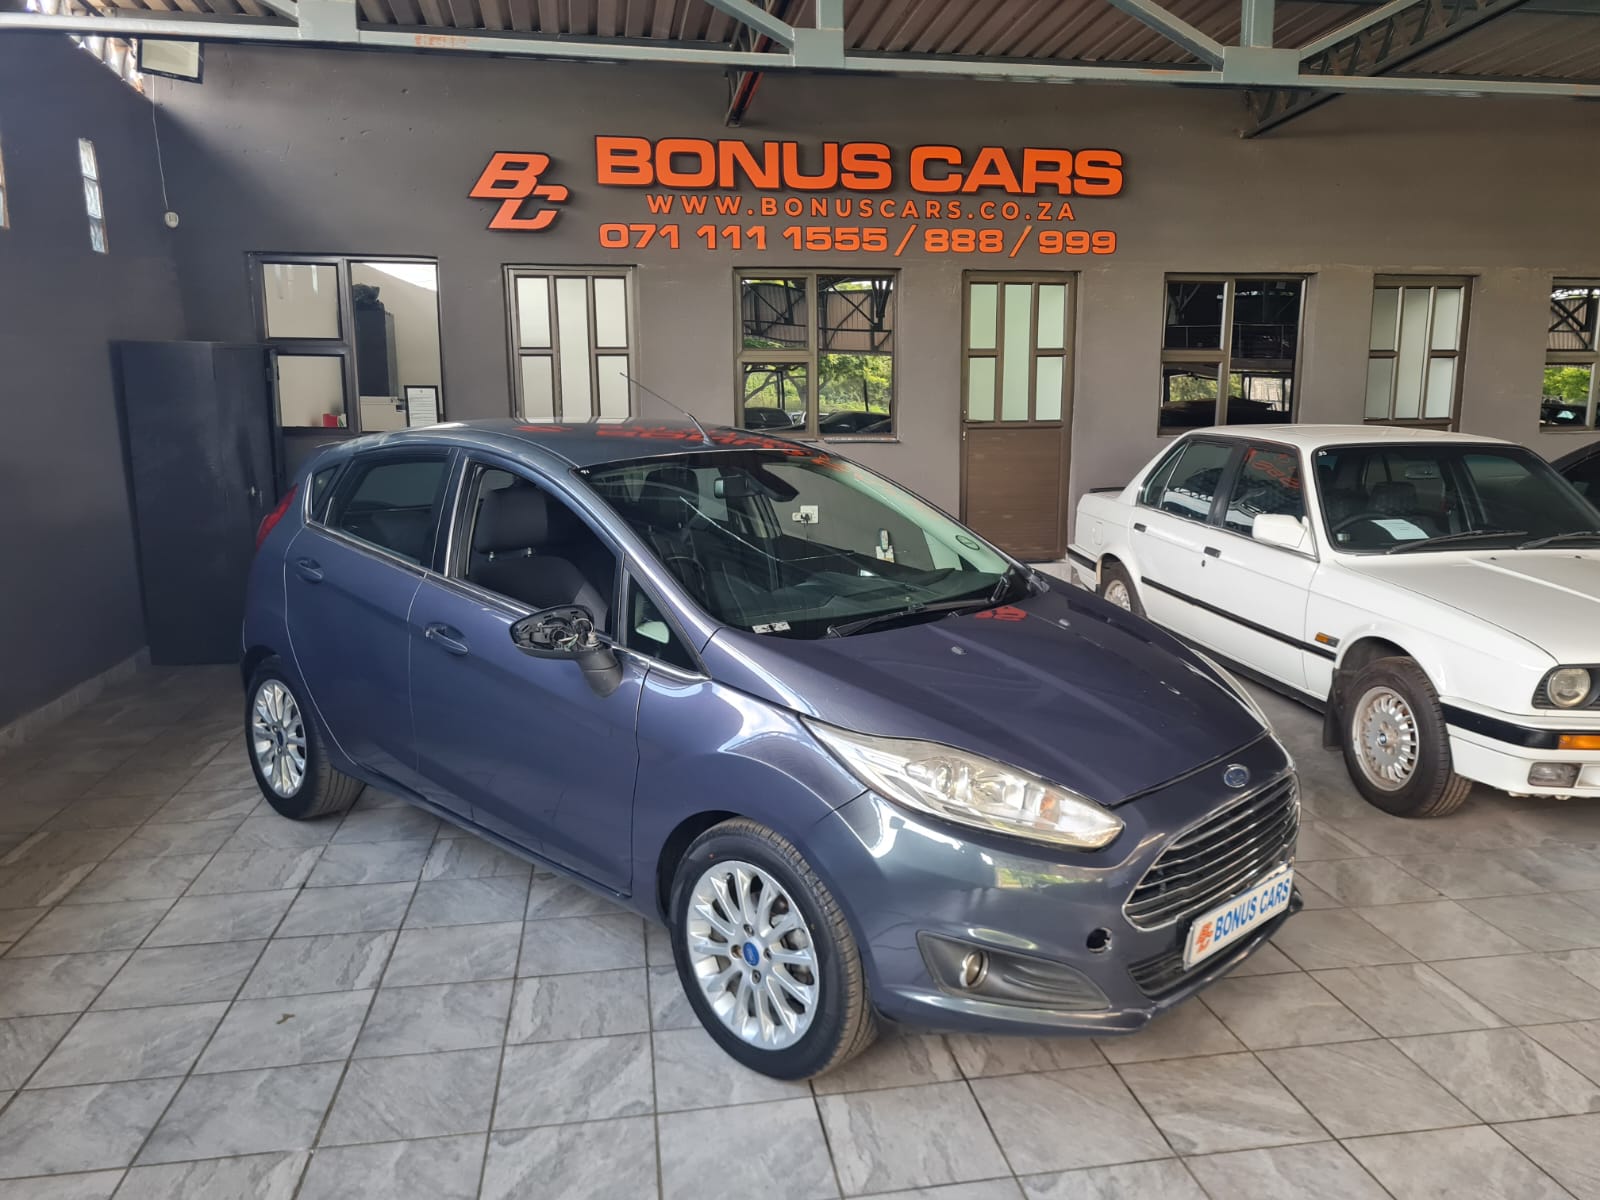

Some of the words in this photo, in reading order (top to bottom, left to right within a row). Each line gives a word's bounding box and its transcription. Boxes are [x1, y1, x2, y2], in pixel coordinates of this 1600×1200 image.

[596, 136, 892, 190] BONUS
[910, 146, 1123, 196] CARS
[646, 194, 1075, 222] WWW.BONUSCARS.CO.ZA
[599, 223, 680, 249] 071
[696, 225, 767, 251] 111
[1214, 896, 1258, 942] BONUS
[1260, 878, 1291, 914] CARS
